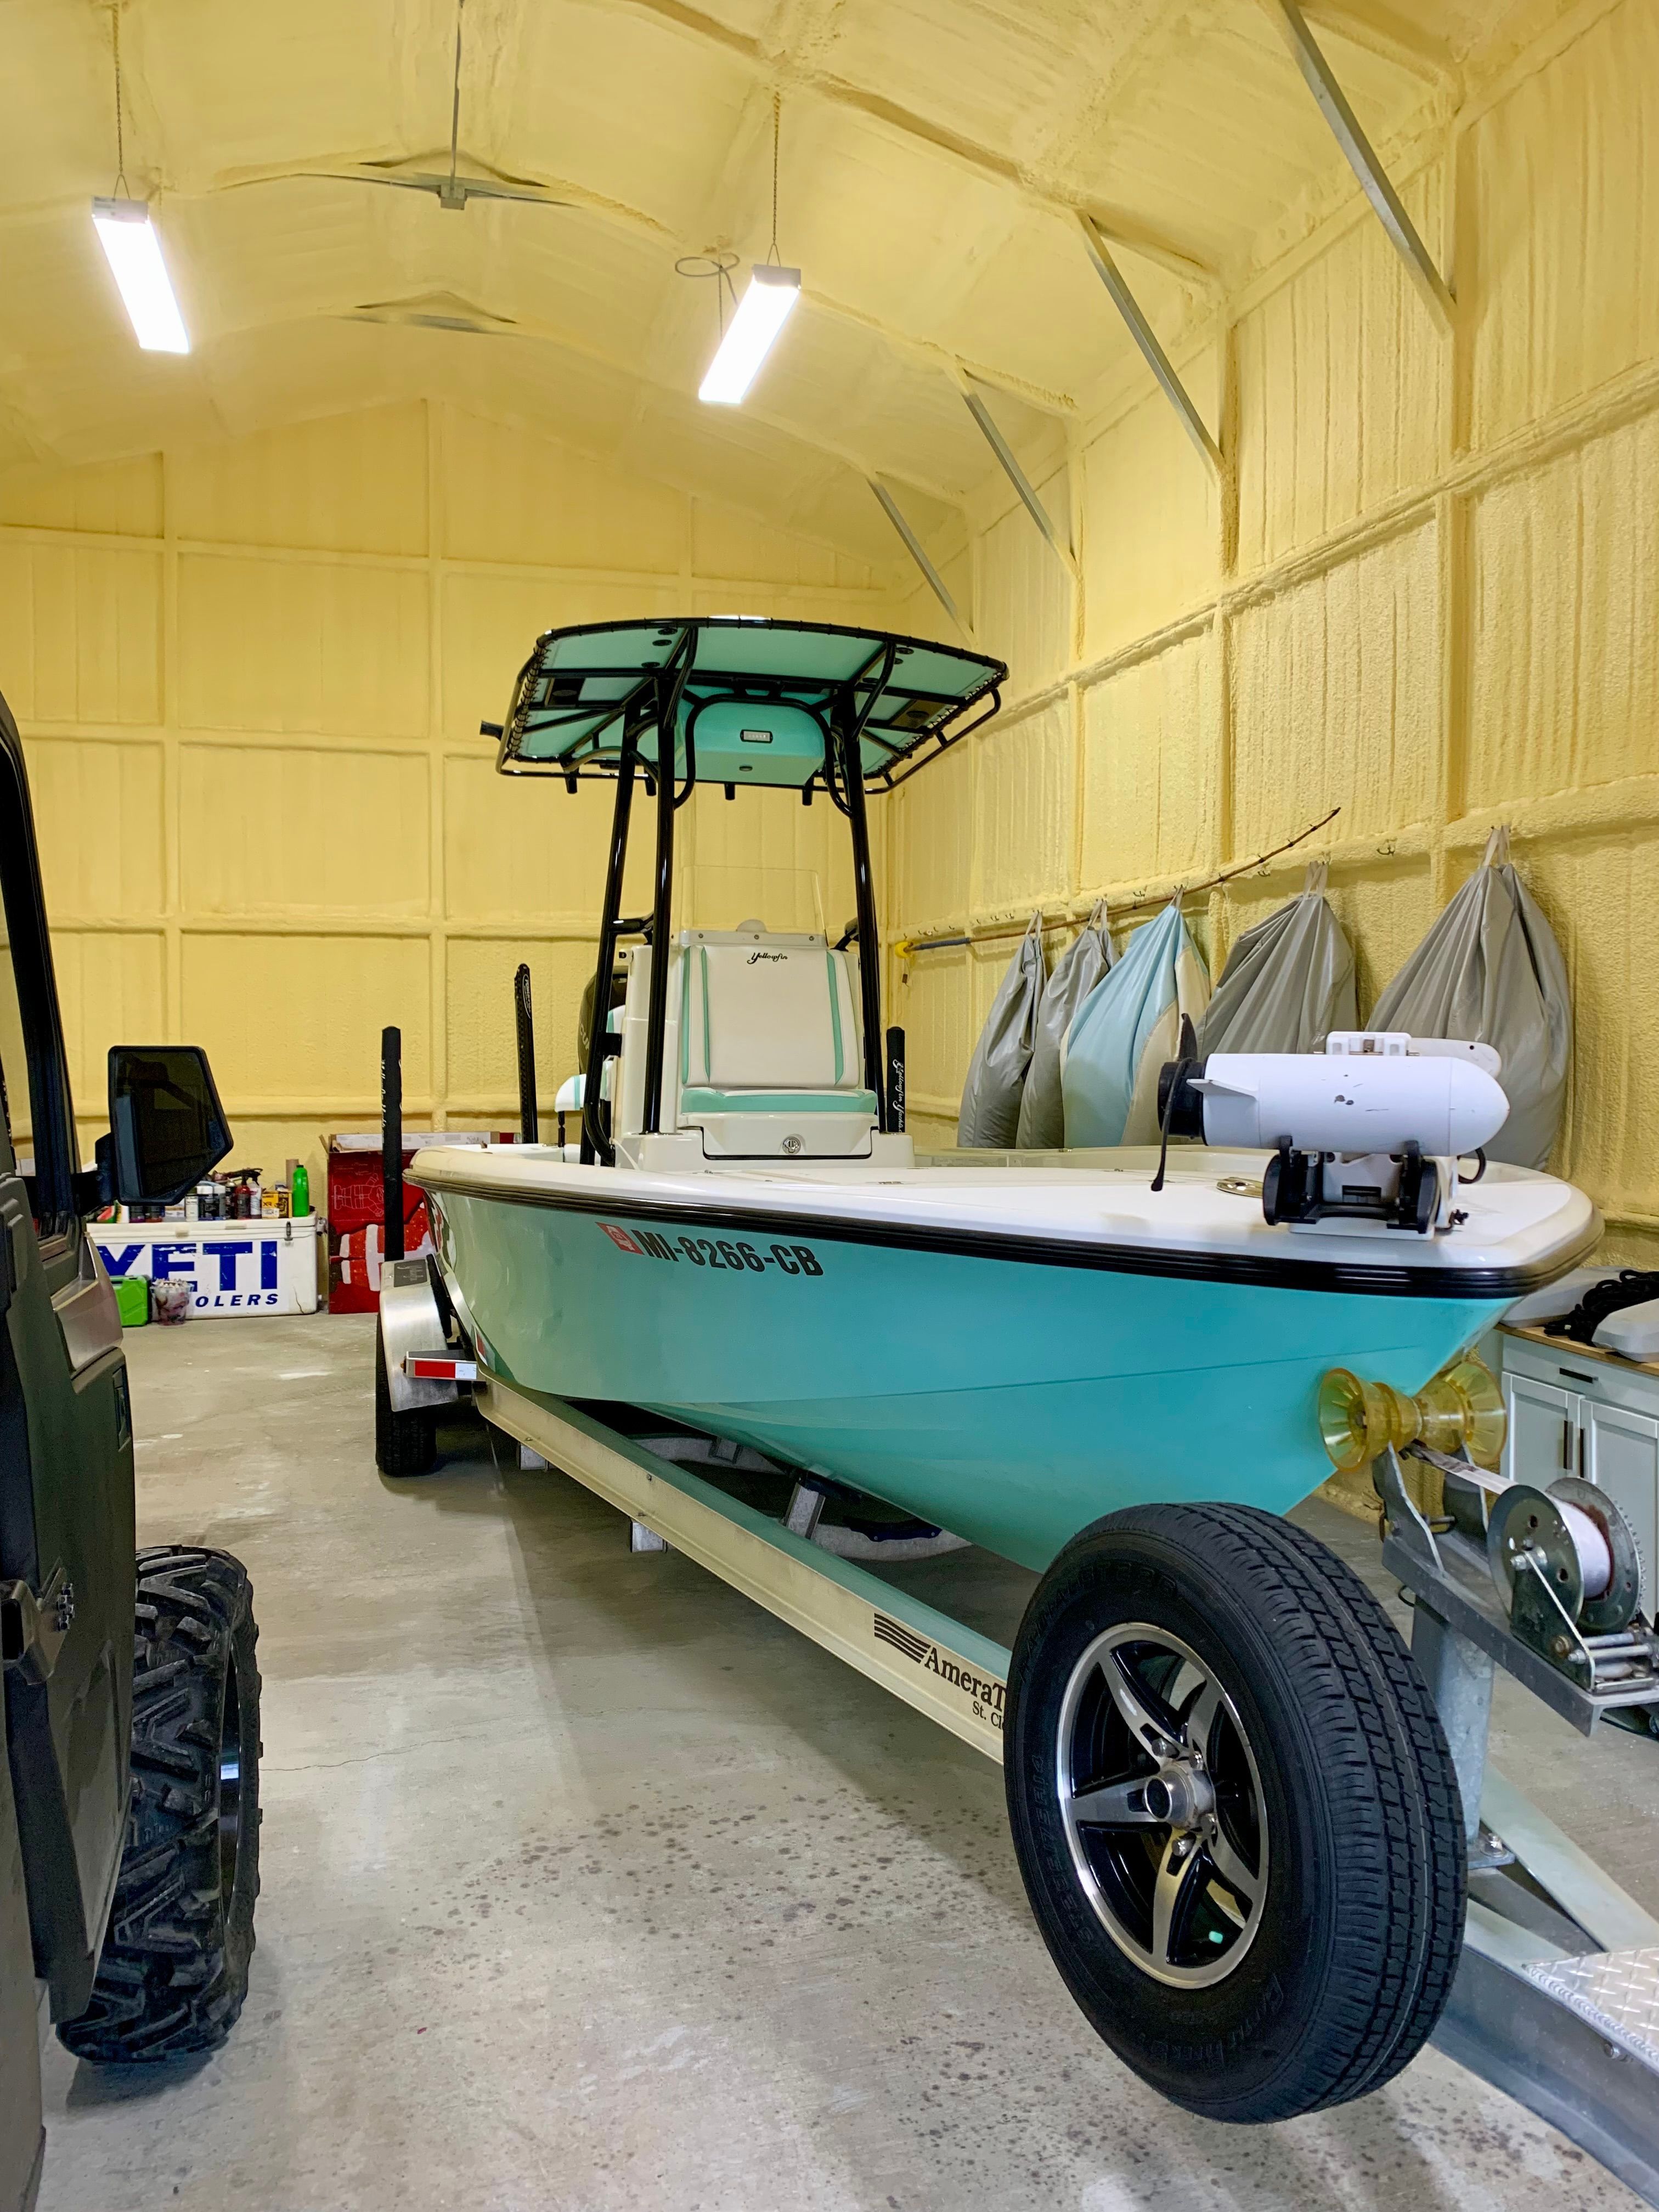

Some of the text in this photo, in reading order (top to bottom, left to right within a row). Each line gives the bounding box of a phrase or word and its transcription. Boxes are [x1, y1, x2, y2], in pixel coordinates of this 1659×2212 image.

[747, 952, 788, 964] Yellowfin
[96, 1240, 277, 1292] YETI
[630, 1229, 823, 1276] MI-8266-CB
[195, 1293, 279, 1307] OLERS
[924, 1646, 1007, 1712] AmeraT
[972, 1701, 1004, 1730] St. Cl
